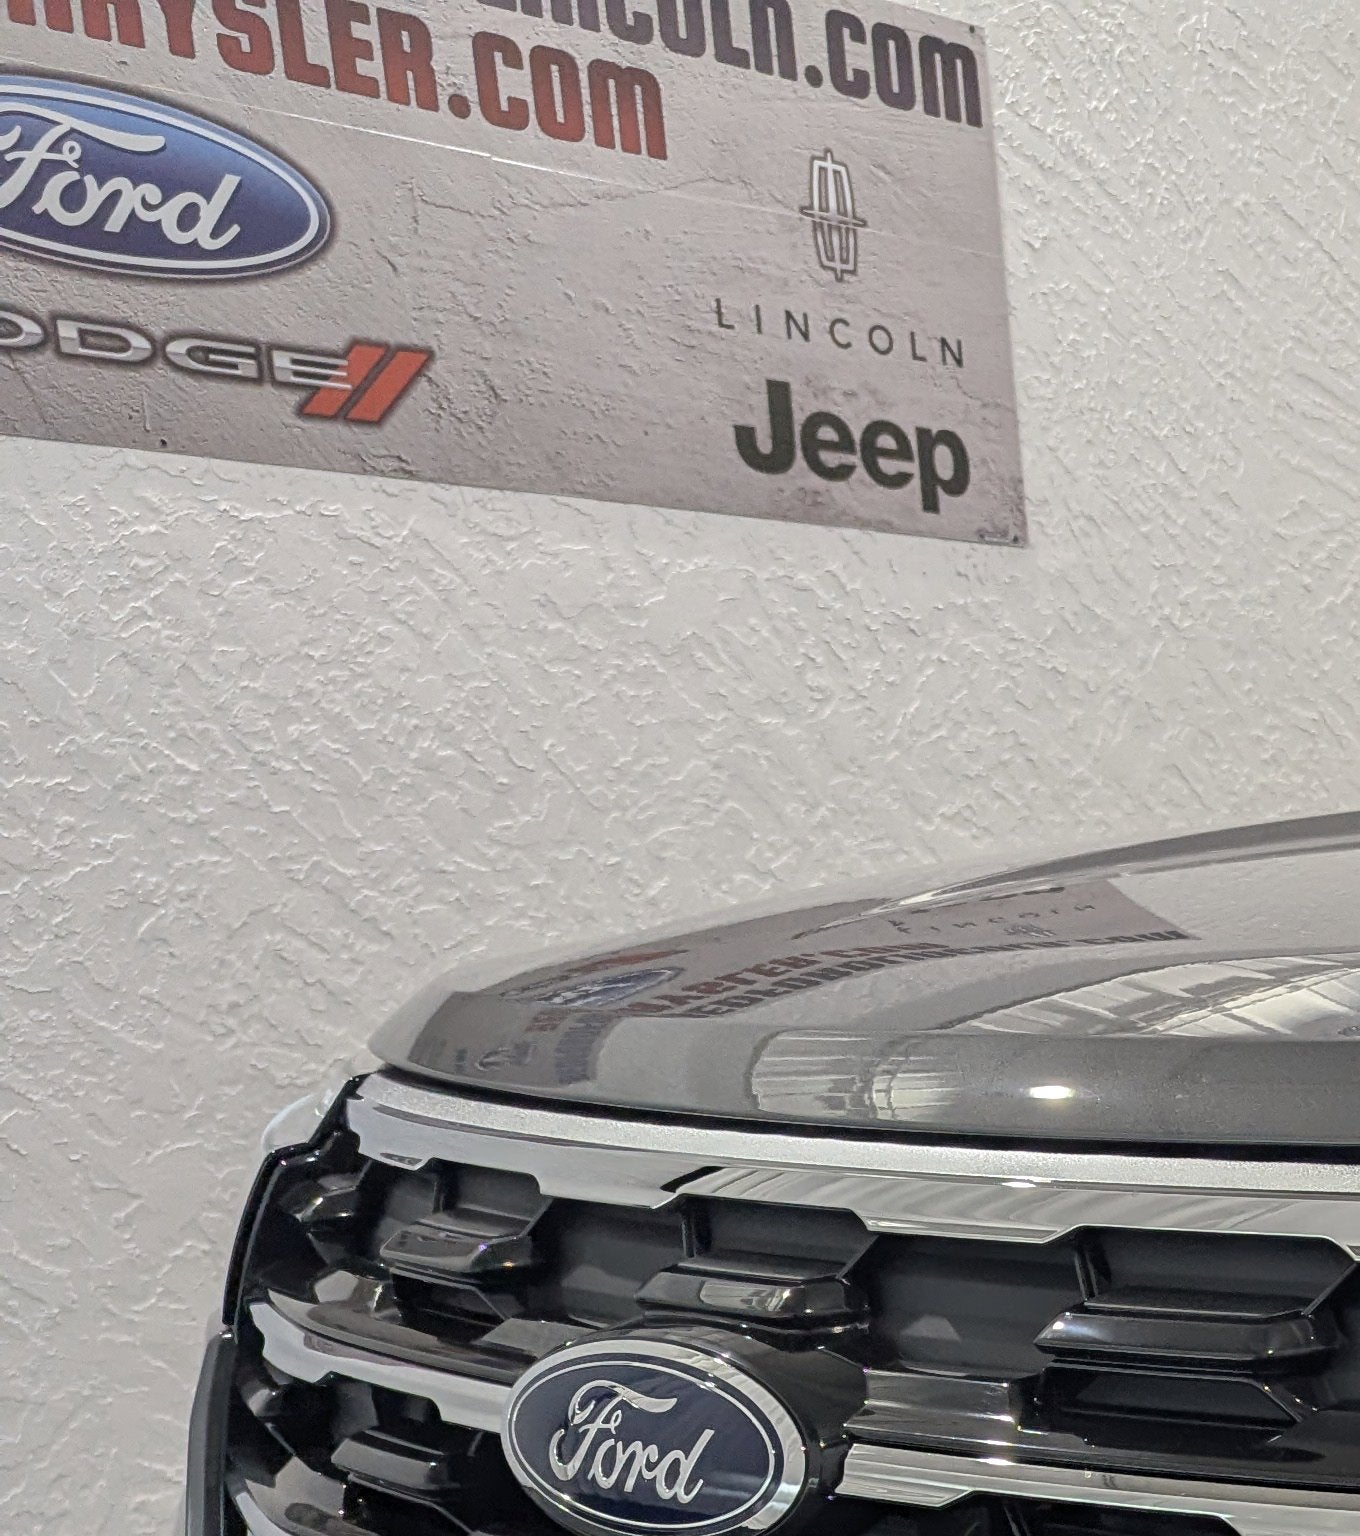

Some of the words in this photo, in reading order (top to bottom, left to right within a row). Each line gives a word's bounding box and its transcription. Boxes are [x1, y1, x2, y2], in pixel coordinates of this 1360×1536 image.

[478, 0, 984, 129] COLN.COM
[0, 101, 242, 250] Ford
[714, 297, 965, 369] LINCOLN
[733, 378, 971, 515] Jeep
[549, 1378, 715, 1504] Ford
